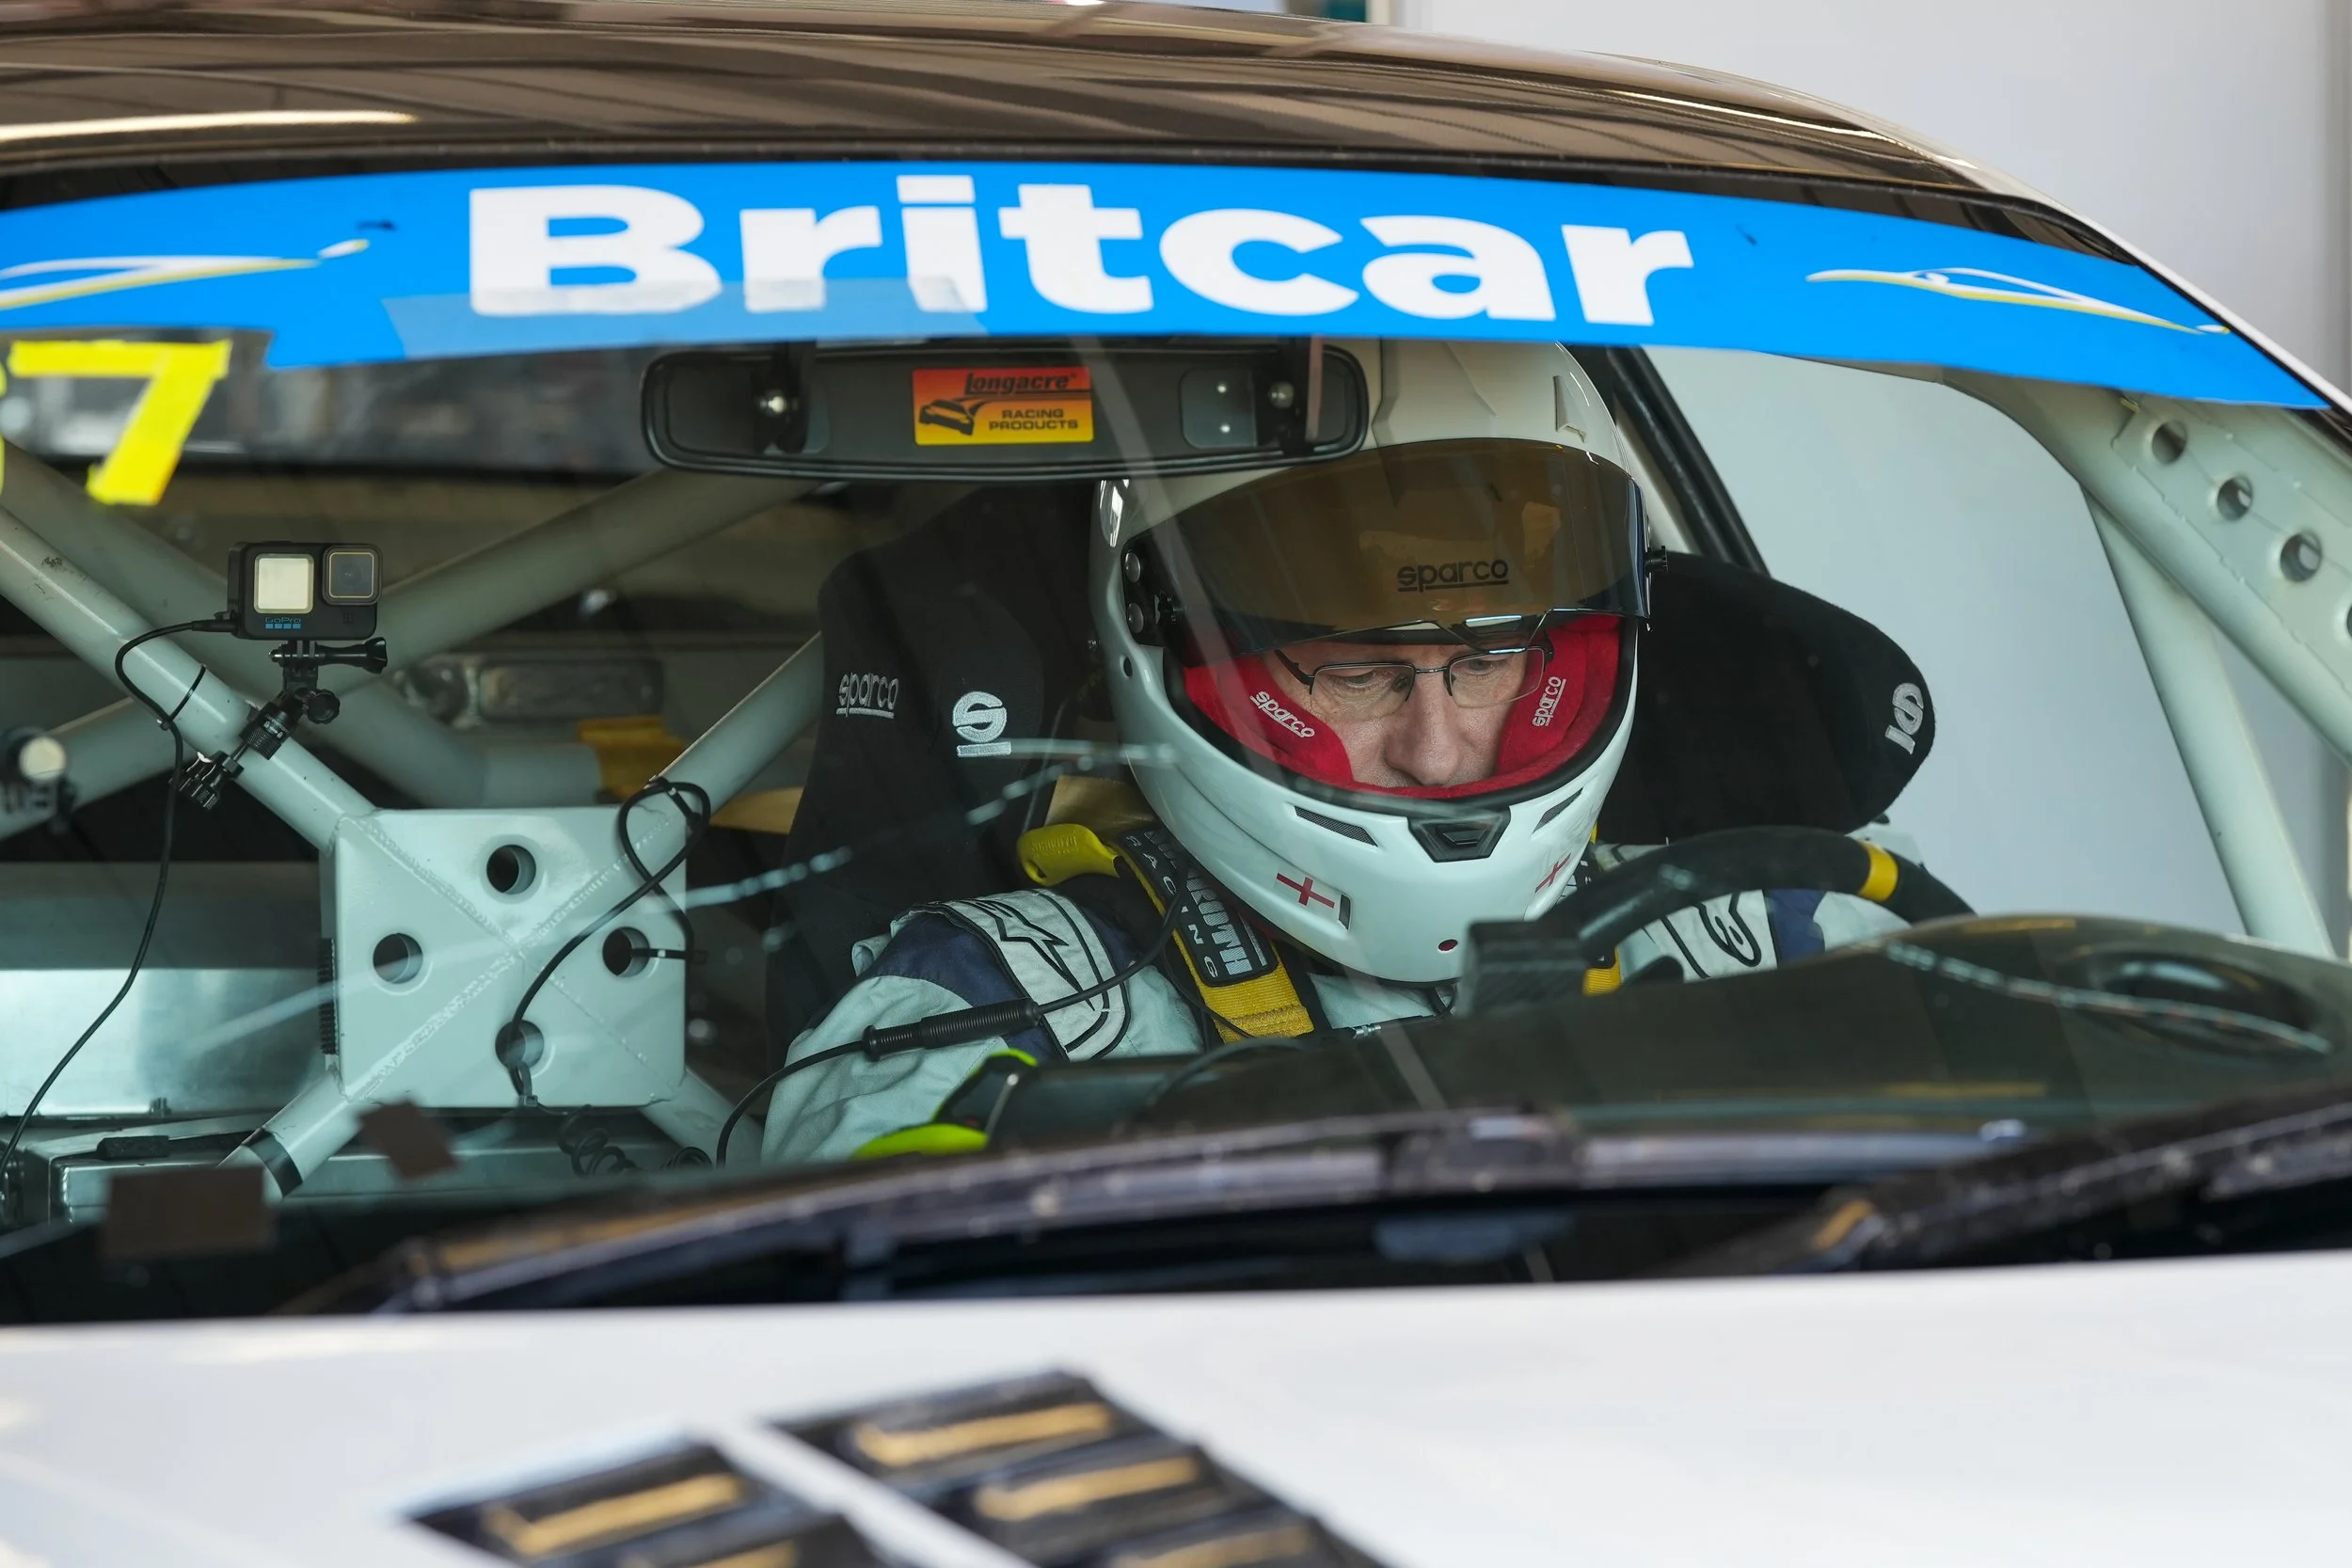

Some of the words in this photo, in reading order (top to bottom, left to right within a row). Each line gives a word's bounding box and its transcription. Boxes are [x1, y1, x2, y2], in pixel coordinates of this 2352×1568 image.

[469, 174, 1694, 327] Britcar
[0, 340, 232, 506] 7
[989, 420, 1079, 431] PRODUCTS
[1002, 408, 1065, 420] RACING
[1397, 559, 1510, 594] sparco
[836, 672, 899, 719] sparco
[1249, 690, 1316, 738] sparco
[1532, 675, 1566, 727] sparco
